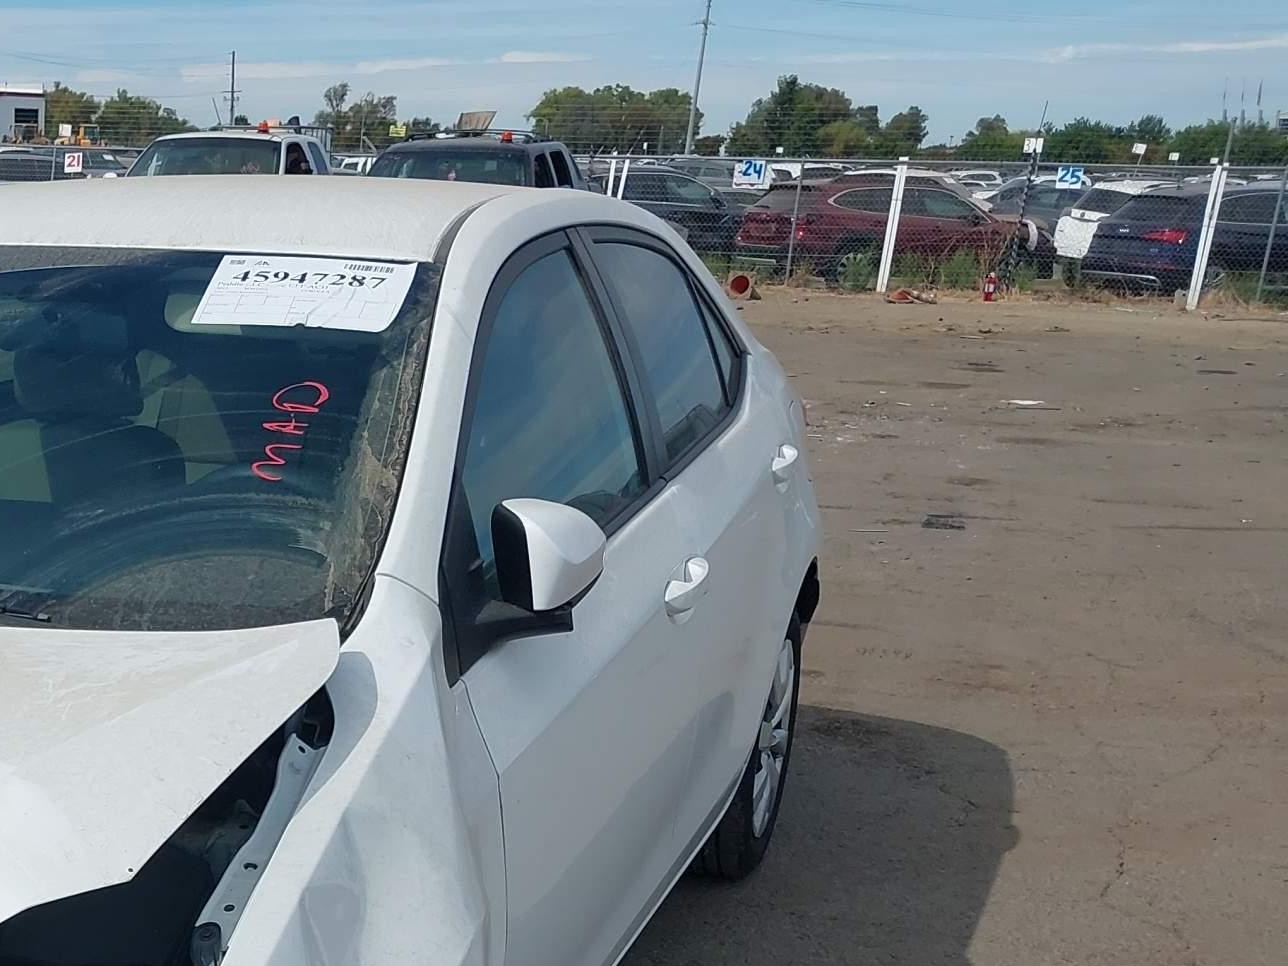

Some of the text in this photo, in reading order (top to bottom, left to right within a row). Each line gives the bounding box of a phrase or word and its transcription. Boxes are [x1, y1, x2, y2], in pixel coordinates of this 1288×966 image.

[67, 154, 80, 167] 21
[742, 161, 764, 180] 24
[1058, 167, 1082, 184] 25
[233, 270, 388, 289] 45947287
[250, 380, 331, 482] MAD
